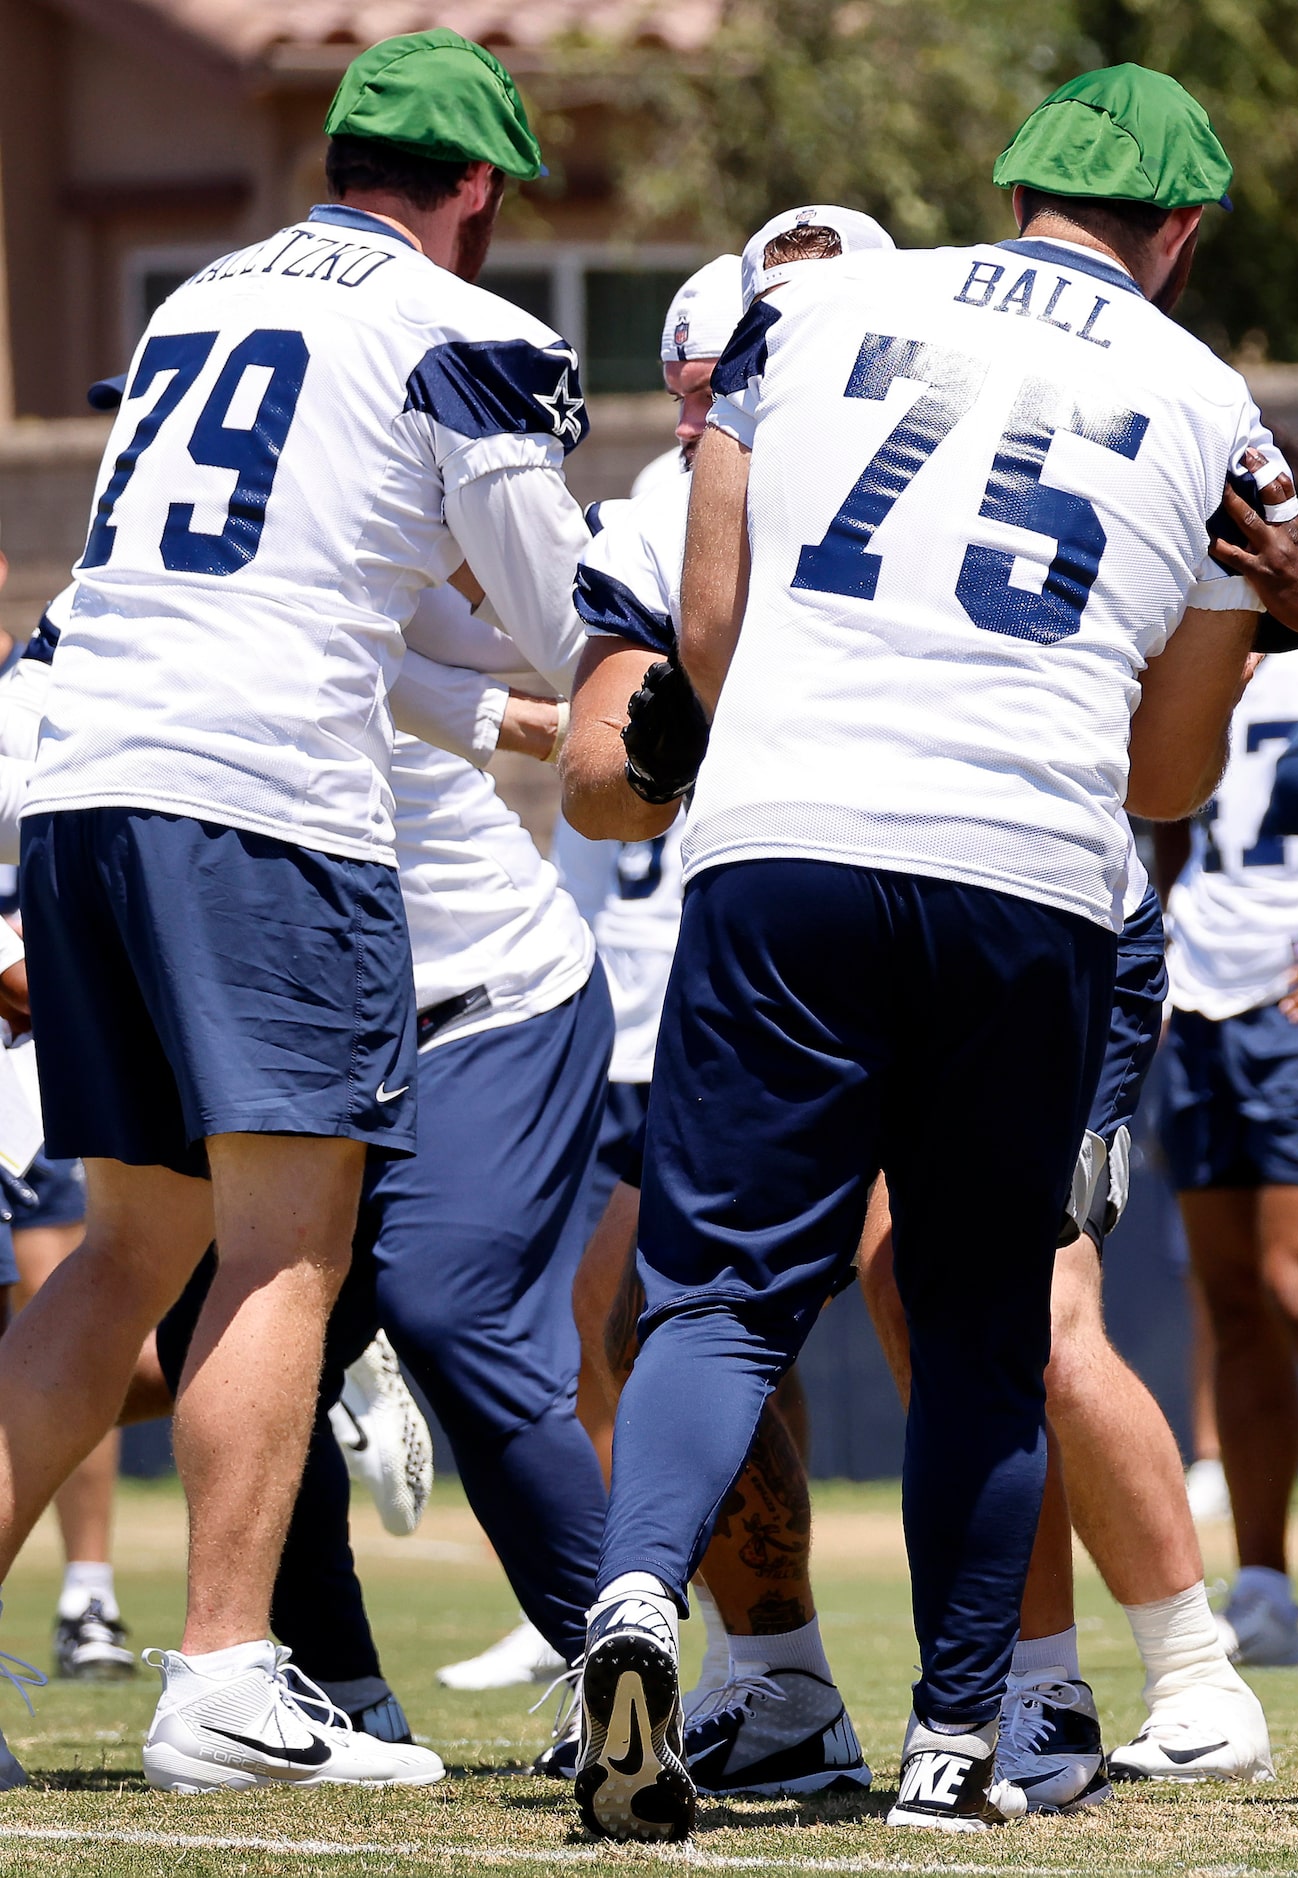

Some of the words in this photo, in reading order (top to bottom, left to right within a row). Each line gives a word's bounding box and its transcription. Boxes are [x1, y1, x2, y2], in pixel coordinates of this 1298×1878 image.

[953, 261, 1112, 349] BALL
[77, 328, 310, 577] 79
[790, 331, 1150, 646] 75
[199, 1746, 270, 1775] FORCE
